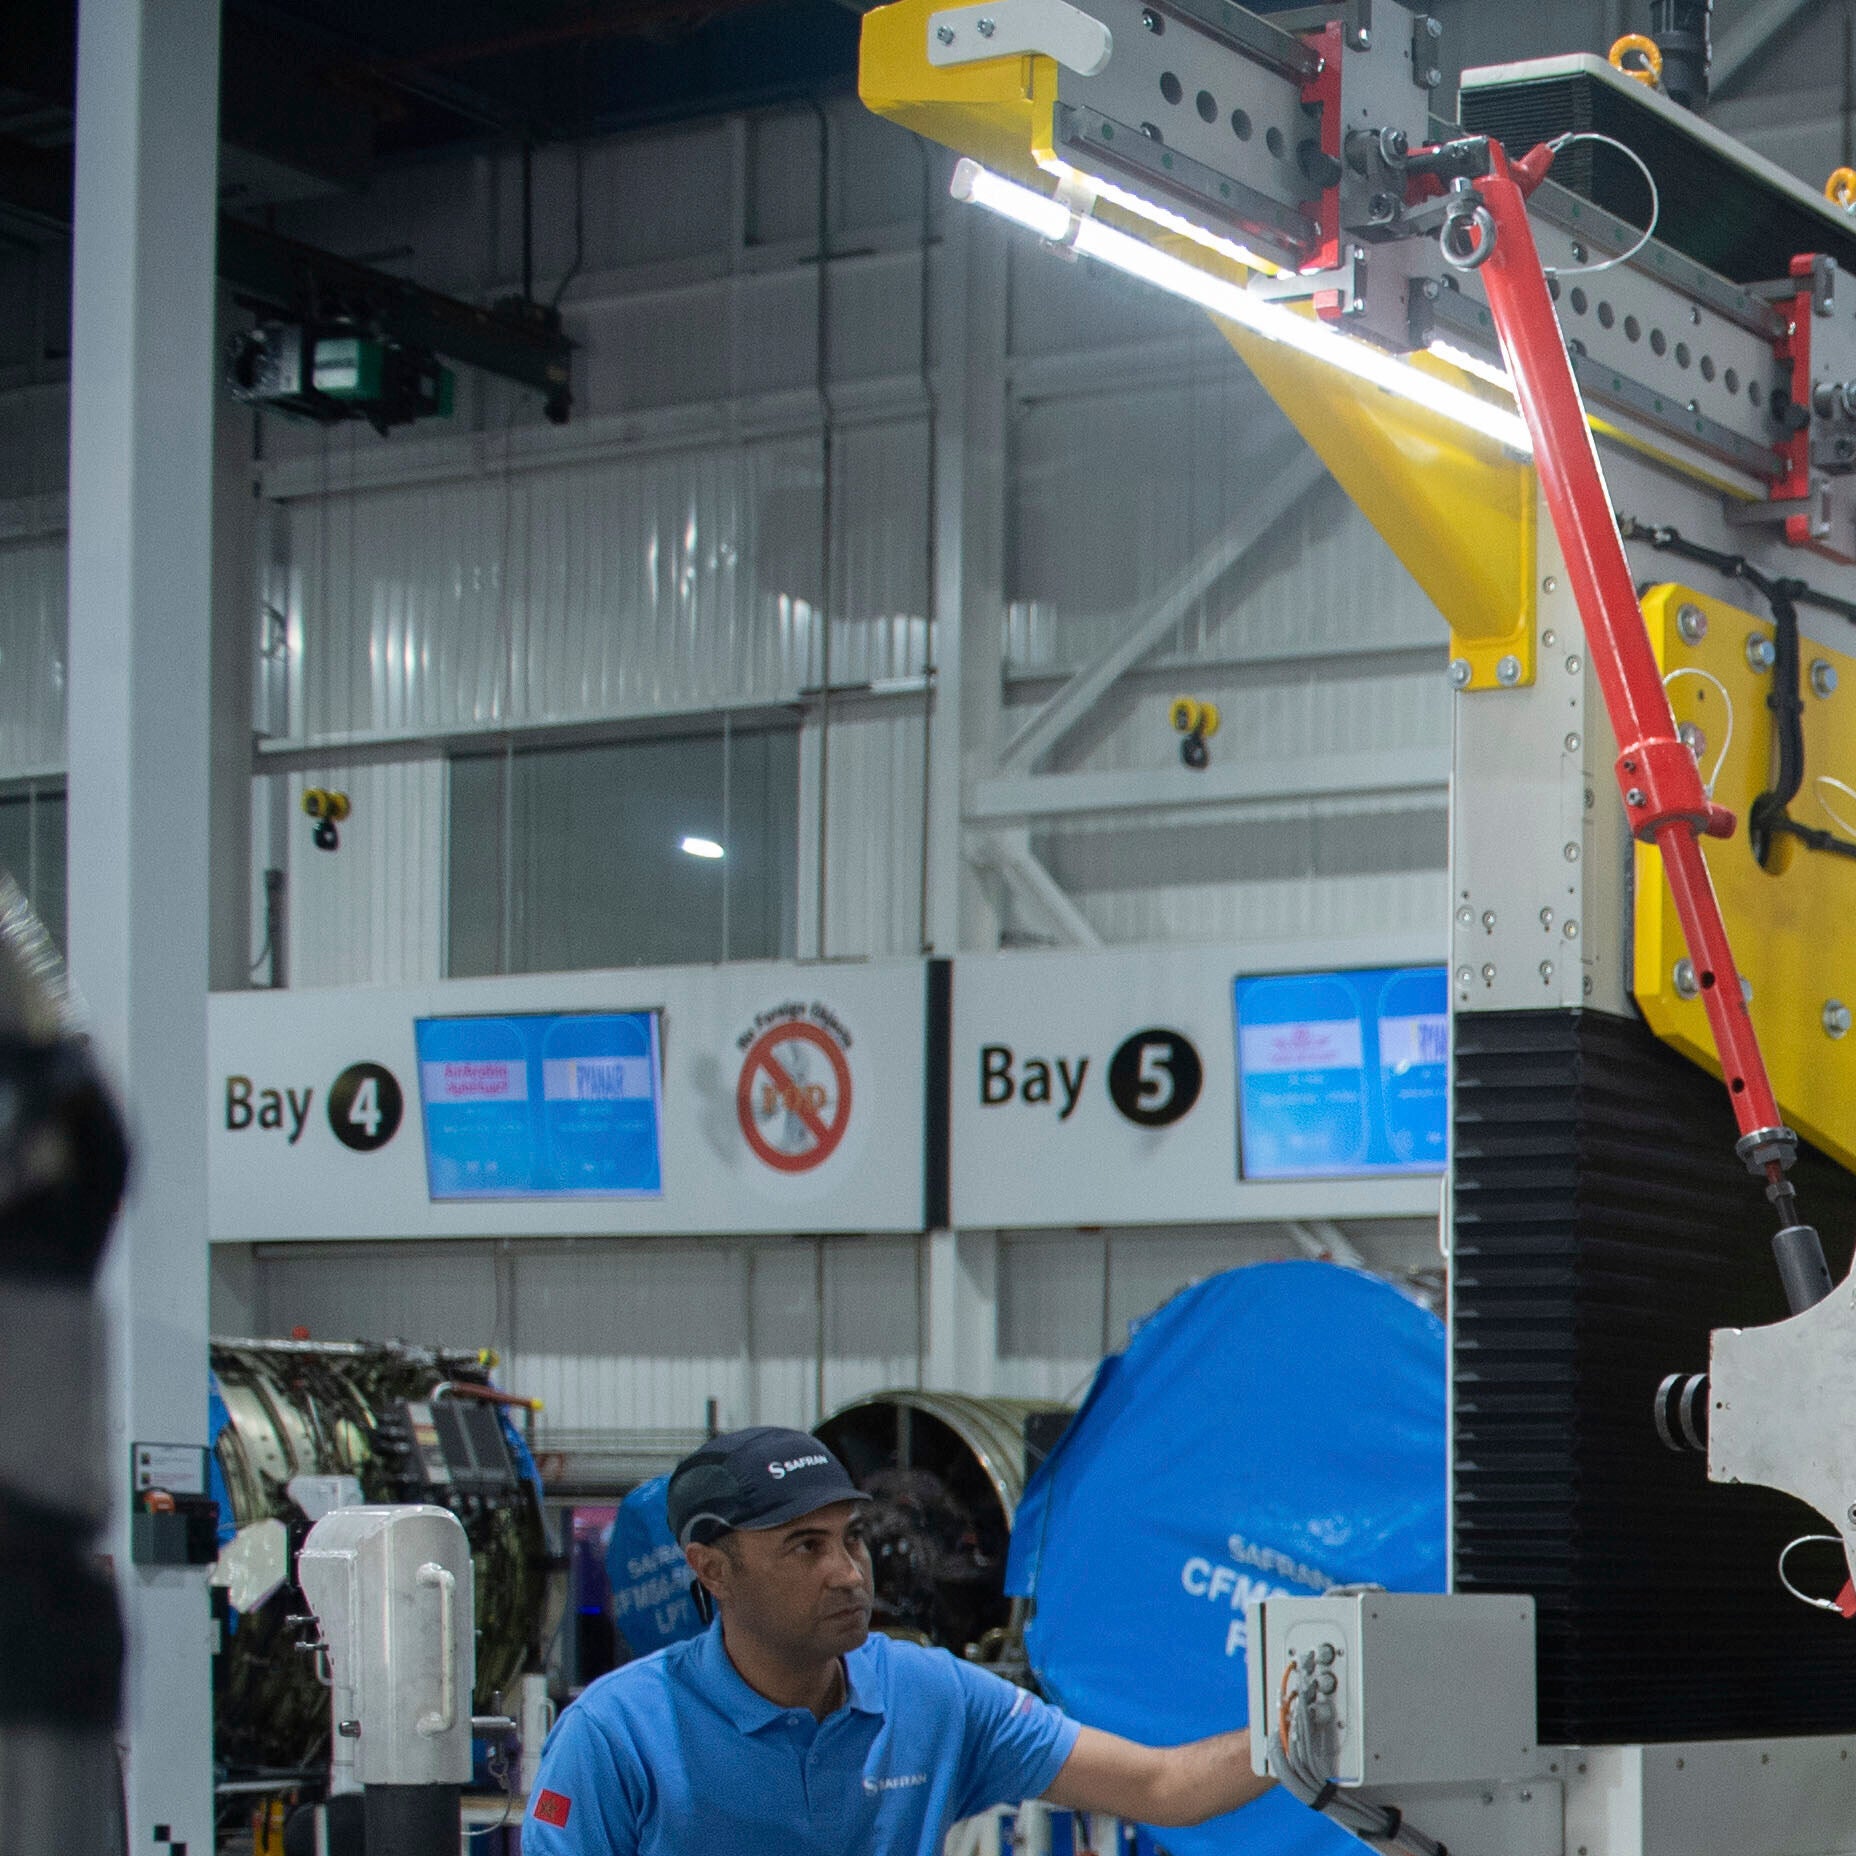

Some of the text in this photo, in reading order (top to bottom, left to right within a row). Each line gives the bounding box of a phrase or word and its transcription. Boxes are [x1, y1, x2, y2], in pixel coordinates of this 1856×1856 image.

[225, 1075, 381, 1145] Bay 4
[980, 1045, 1175, 1120] Bay 5
[784, 1455, 828, 1472] SAFRAN
